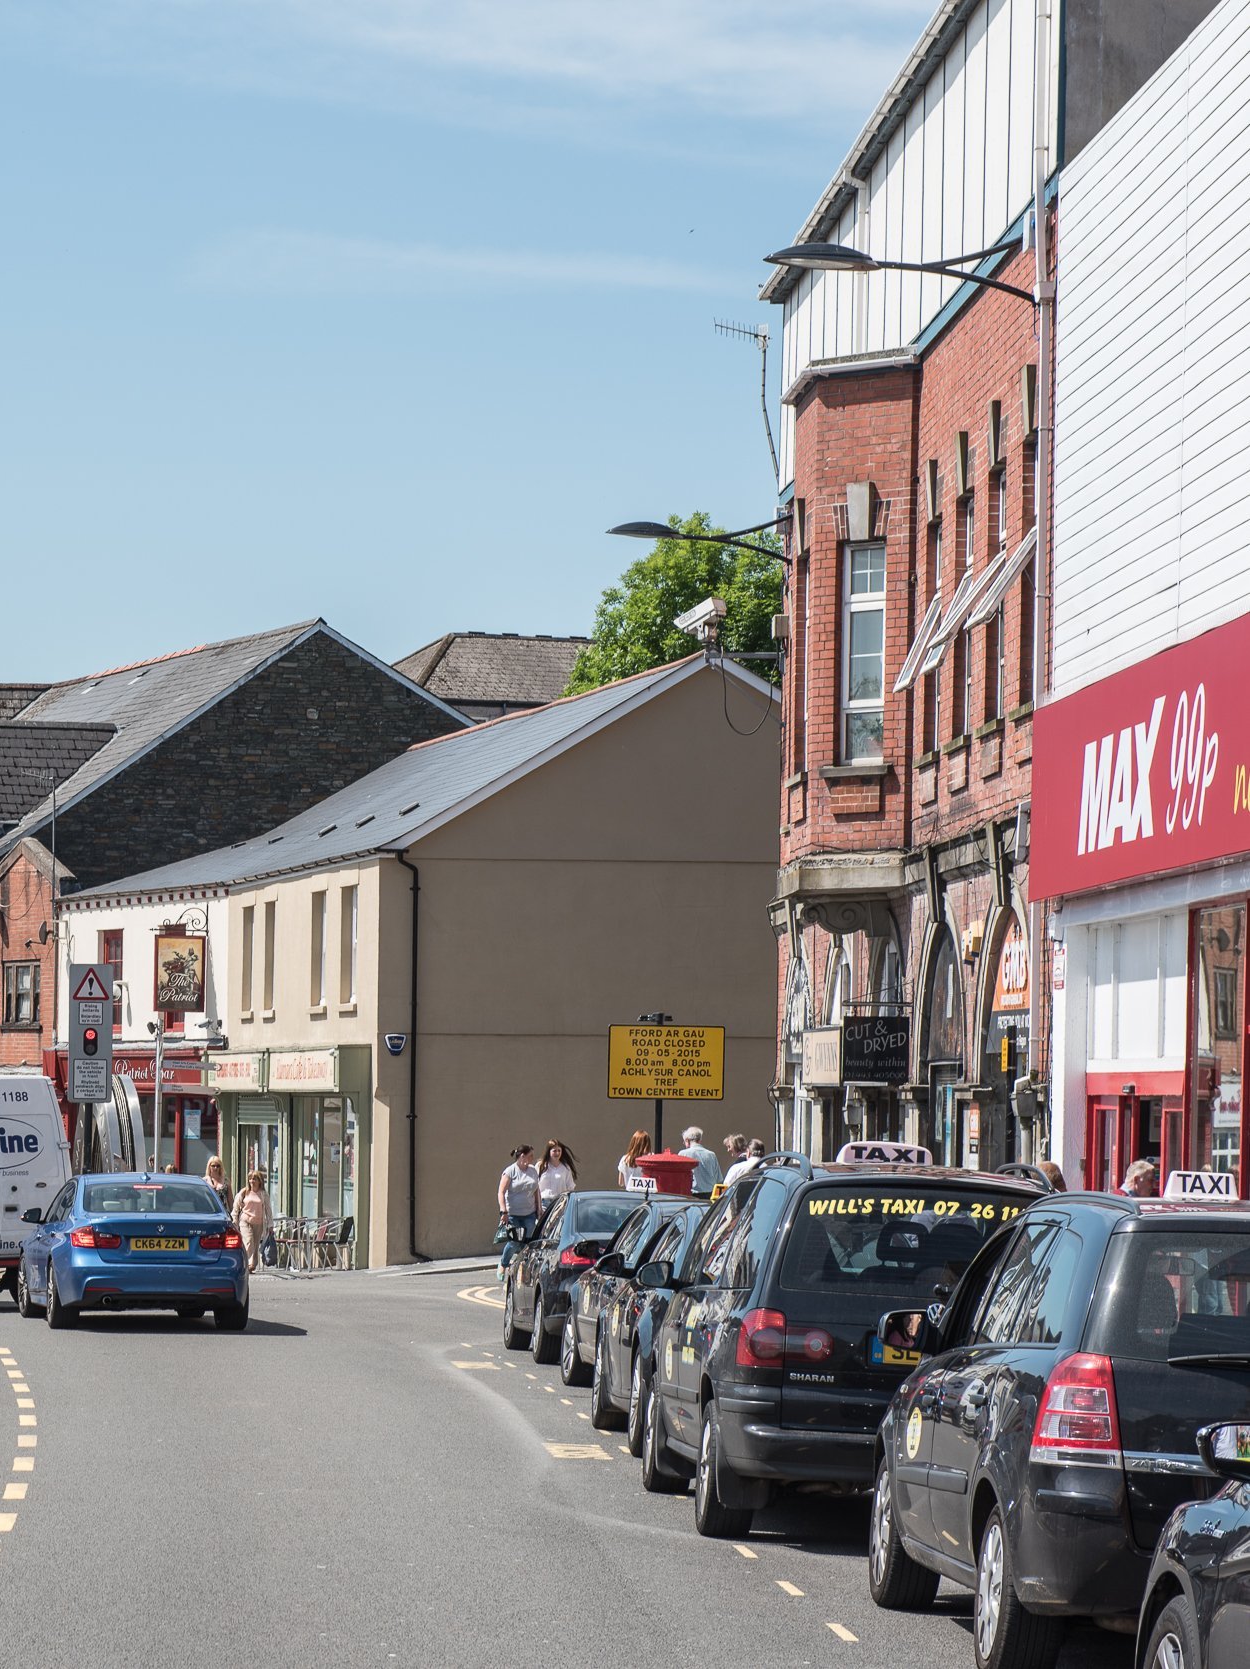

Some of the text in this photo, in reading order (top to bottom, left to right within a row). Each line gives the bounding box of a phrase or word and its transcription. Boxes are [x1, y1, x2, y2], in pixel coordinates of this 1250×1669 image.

[1077, 695, 1166, 856] MAX
[1165, 682, 1219, 834] 99p
[168, 972, 190, 987] The
[159, 988, 198, 1002] Patriot
[629, 1029, 705, 1038] FFORD AR GAU
[845, 1019, 888, 1041] CUT &
[632, 1038, 705, 1048] ROAD CLOSED
[863, 1032, 907, 1054] DRYED
[676, 1049, 700, 1057] 2015
[625, 1058, 649, 1066] 8.00
[672, 1059, 694, 1067] 8.00
[696, 1060, 711, 1068] pm
[845, 1056, 906, 1069] beauty within
[114, 1058, 149, 1080] Patriot
[620, 1068, 712, 1077] ACHLYSUR CANOL
[654, 1078, 678, 1086] TREF
[1, 1091, 29, 1102] 1188
[612, 1087, 720, 1097] TOWN CENTRE EVENT
[850, 1146, 925, 1164] TAXI
[1, 1169, 30, 1177] business
[631, 1178, 654, 1189] TAXI
[1176, 1173, 1230, 1195] TAXI
[809, 1198, 1026, 1221] WILL'S TAXI 07 26 11
[135, 1239, 185, 1249] CK64 ZZM
[789, 1372, 835, 1383] SHARAN
